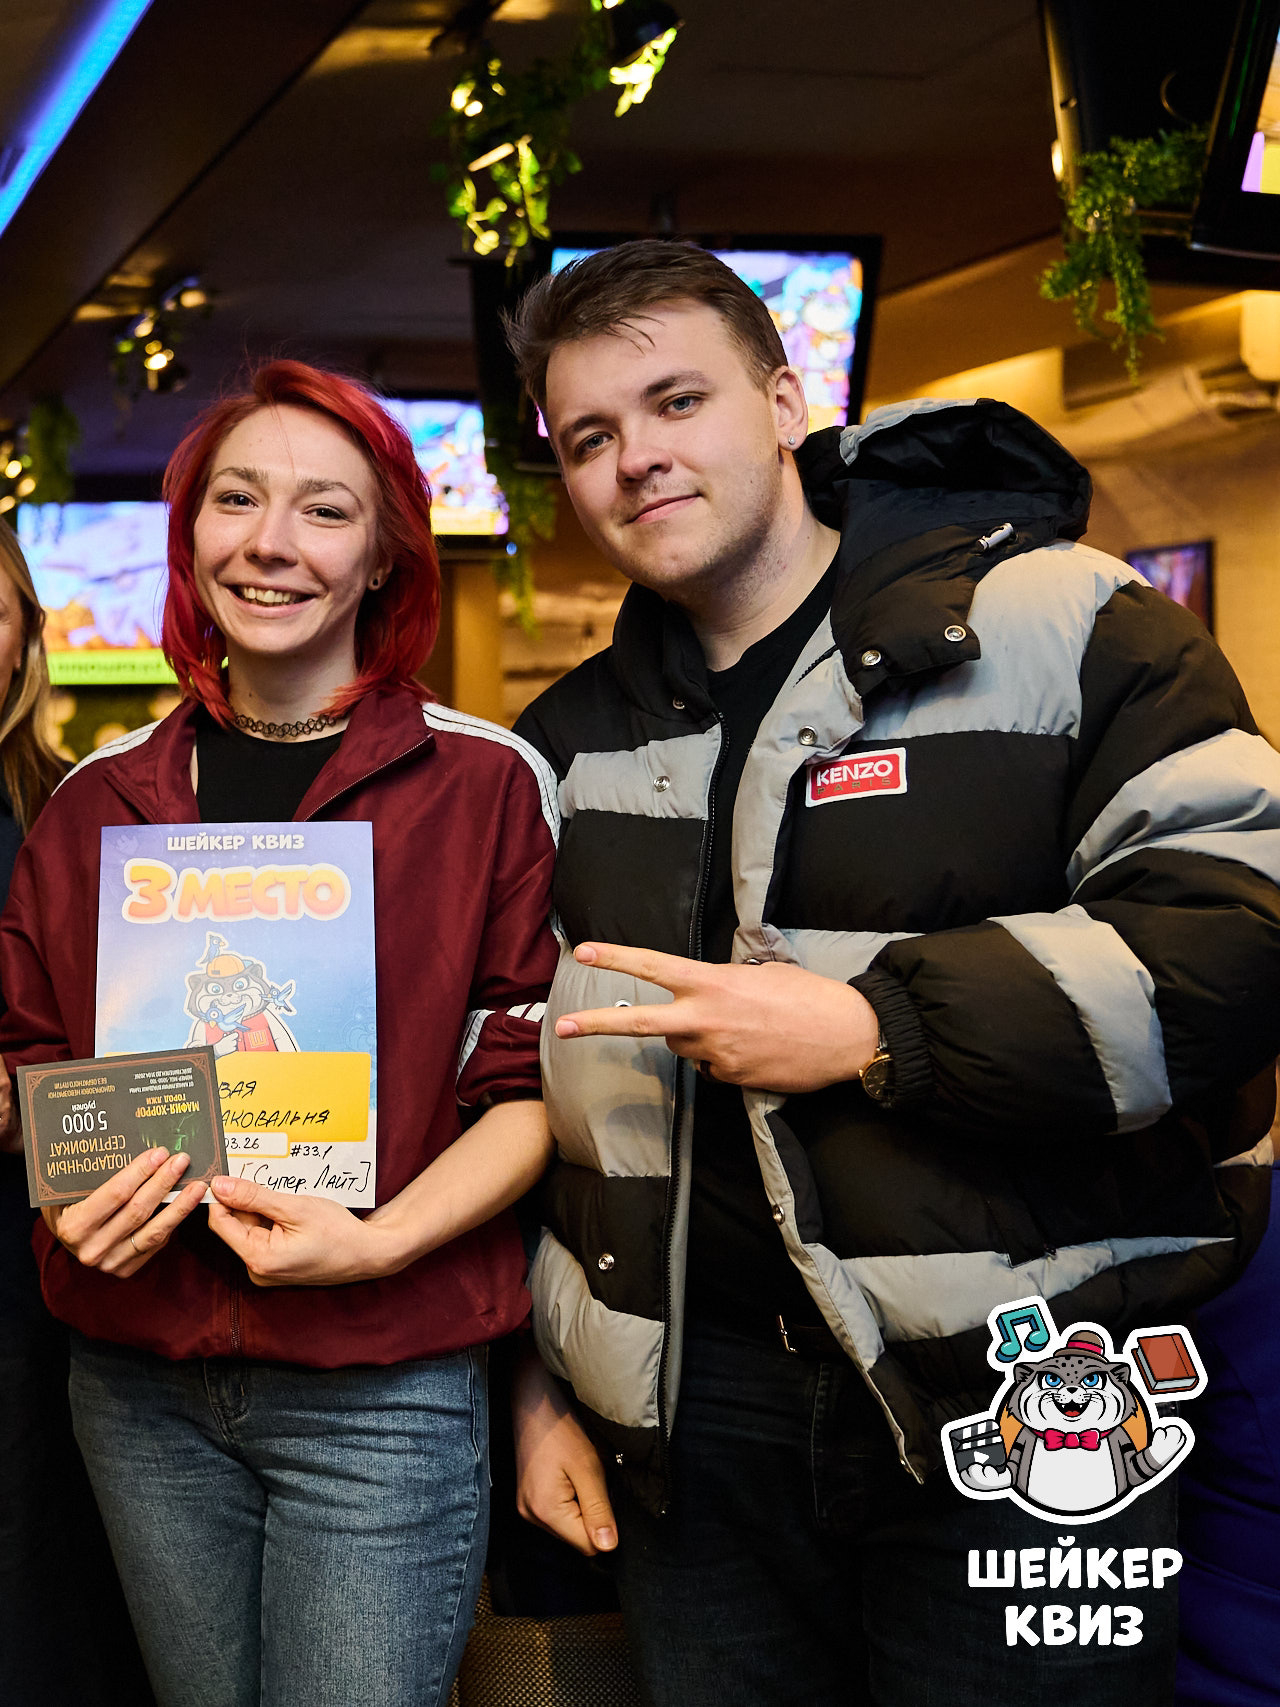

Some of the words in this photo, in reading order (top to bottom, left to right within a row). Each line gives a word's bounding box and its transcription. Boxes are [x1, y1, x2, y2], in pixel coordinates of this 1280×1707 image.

[816, 759, 894, 787] KENZO
[817, 777, 891, 795] PARIS
[167, 832, 246, 851] ШЕЙКЕР
[252, 834, 305, 850] КВИЗ
[125, 862, 175, 921] 3
[176, 866, 349, 919] МЕСТО
[164, 1093, 186, 1103] ГОРОД
[218, 1080, 257, 1099] ВАЯ
[71, 1100, 96, 1112] рублей
[135, 1101, 200, 1118] МАФИЯ-ХОРРОР
[146, 1096, 162, 1105] ЛЖИ
[62, 1112, 95, 1135] 000
[97, 1110, 108, 1131] 5
[49, 1134, 126, 1157] СЕРТИФИКАТ
[46, 1153, 132, 1178] ПОДАРОЧНЫЙ
